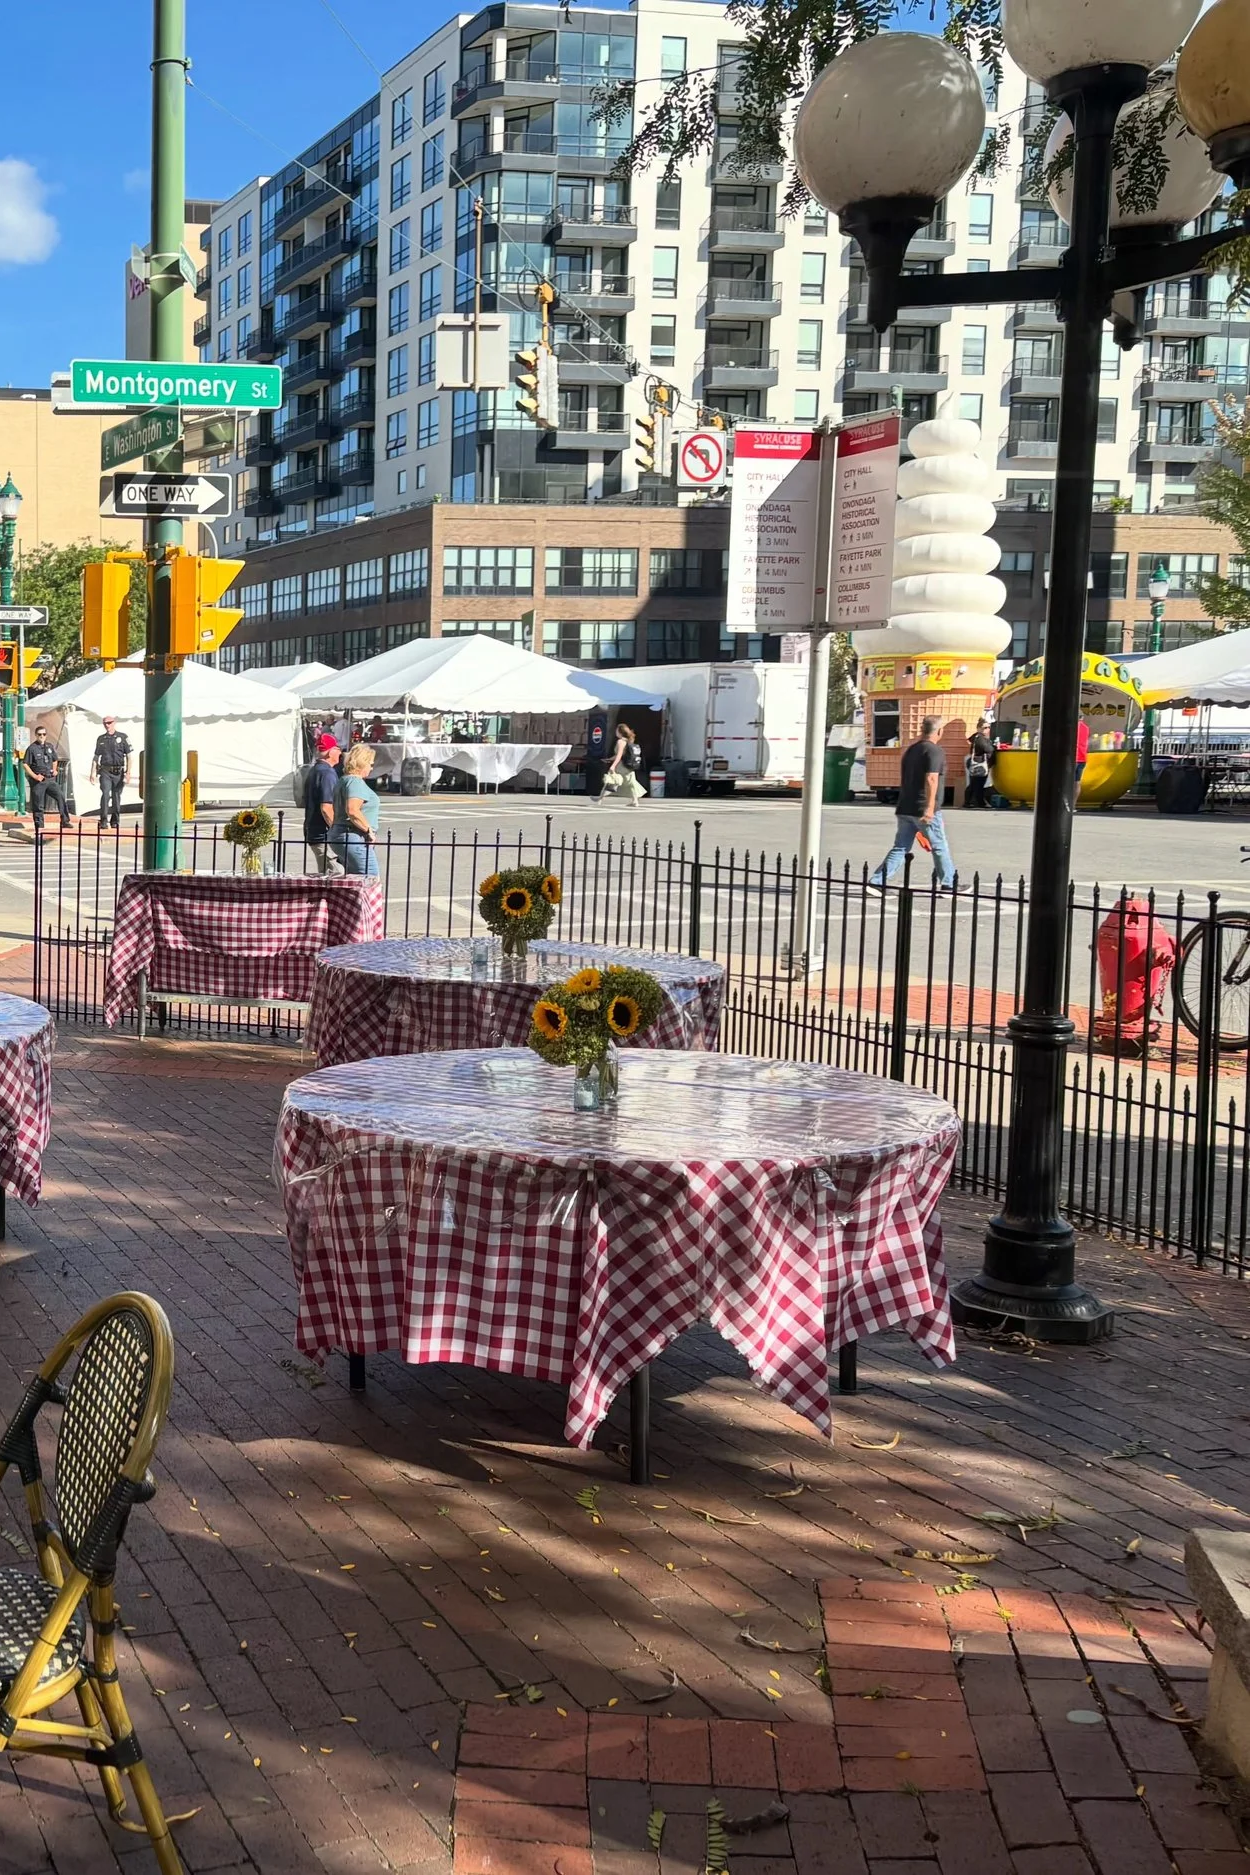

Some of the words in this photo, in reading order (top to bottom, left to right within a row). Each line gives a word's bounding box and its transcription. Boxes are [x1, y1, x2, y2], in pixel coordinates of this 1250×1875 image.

[85, 369, 237, 403] Montgomery
[251, 381, 268, 399] St
[850, 421, 885, 440] SYRACUSE
[105, 446, 110, 461] E
[113, 420, 162, 458] Washington
[753, 432, 802, 445] SYRACUSE
[746, 472, 764, 481] CITY
[843, 468, 856, 479] CITY
[857, 465, 873, 476] HALL
[127, 486, 158, 502] ONE
[164, 487, 195, 502] WAY
[842, 496, 876, 509] ONONDAGA
[745, 503, 791, 512] ONONDAGA
[841, 507, 876, 520] HISTORICAL
[744, 514, 791, 523] HISTORICAL
[841, 517, 880, 531] ASSOCIATION
[744, 525, 797, 534] ASSOCIATION
[862, 531, 874, 540] MIN
[766, 537, 772, 546] 3
[773, 537, 789, 546] MIN
[839, 551, 864, 562] FAYETTE
[864, 548, 882, 559] PARK
[743, 555, 777, 564] FAYETTE
[778, 556, 800, 565] PARK
[860, 563, 872, 571] MIN
[772, 568, 788, 577] MIN
[741, 586, 786, 595] COLUMBUS
[838, 581, 871, 593] COLUMBUS
[741, 597, 770, 605] CIRCLE
[837, 594, 859, 604] CIRCLE
[770, 609, 786, 617] MIN
[858, 605, 870, 614] MIN
[0, 611, 16, 619] ONE
[18, 611, 32, 619] WAY
